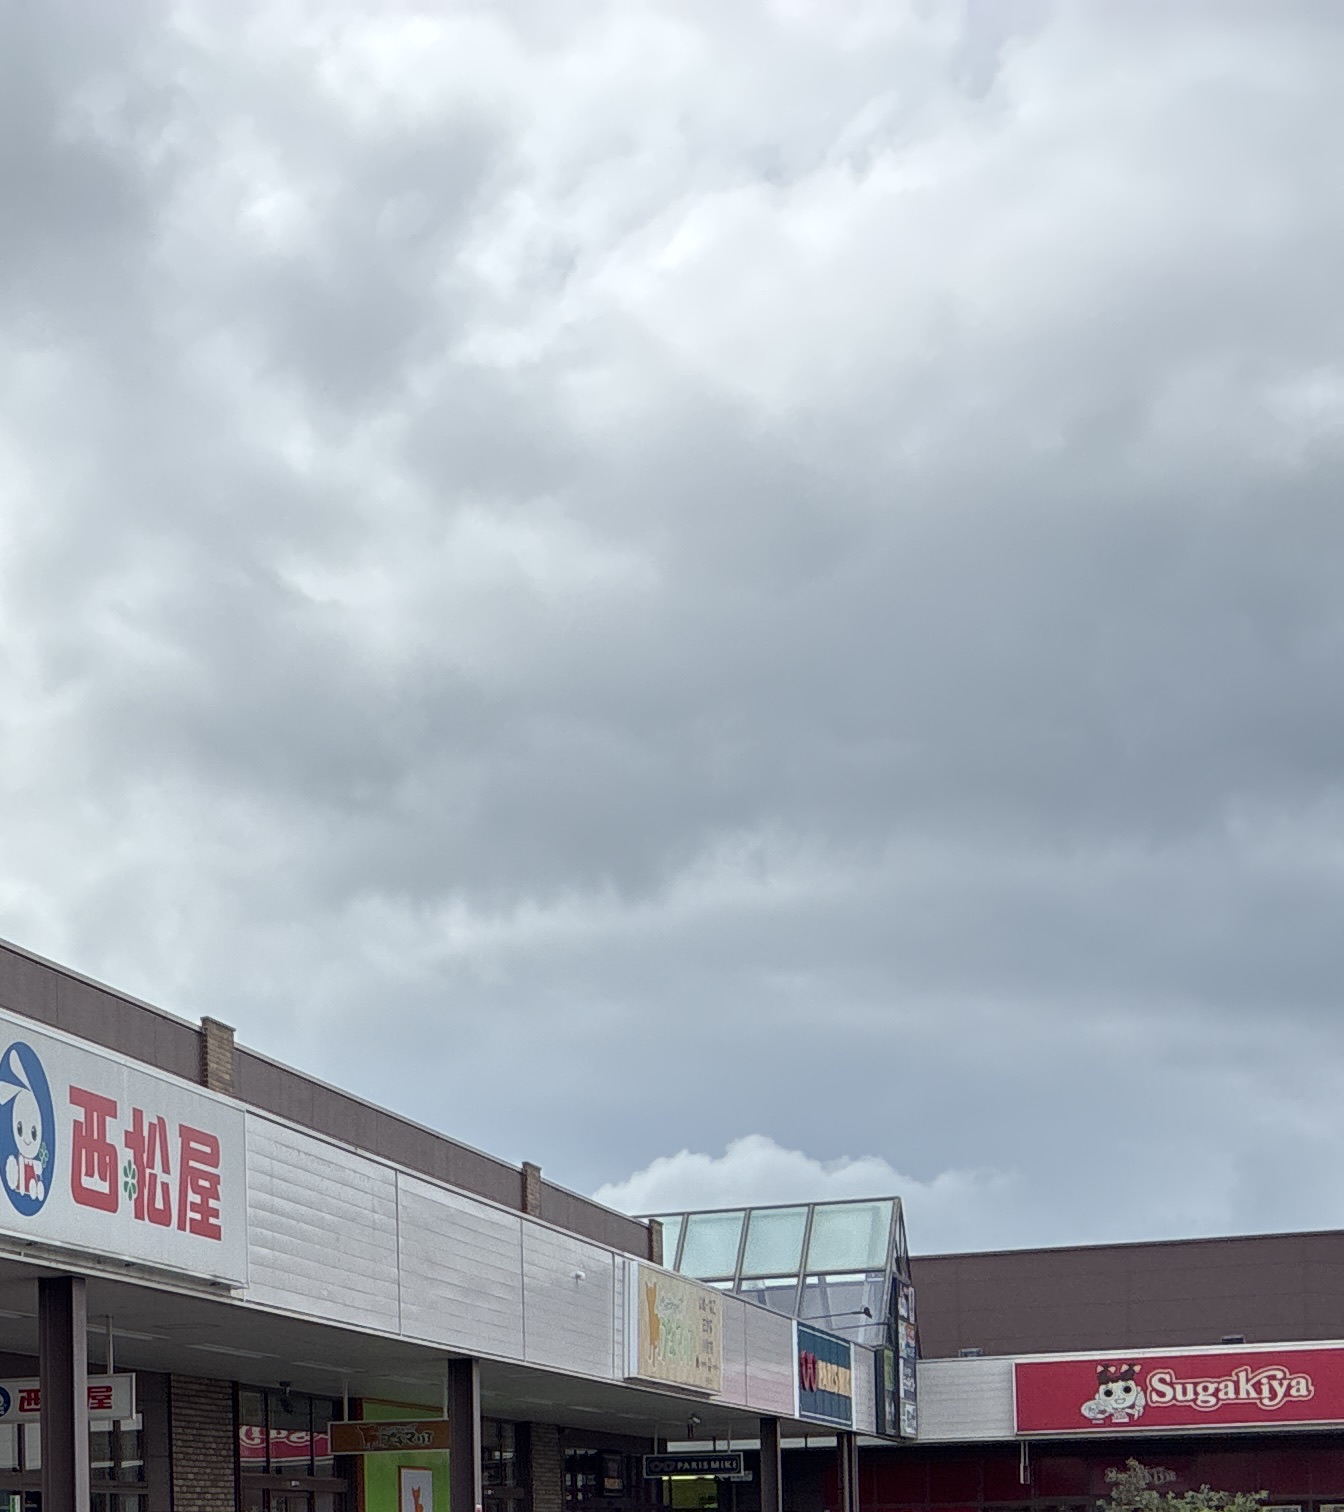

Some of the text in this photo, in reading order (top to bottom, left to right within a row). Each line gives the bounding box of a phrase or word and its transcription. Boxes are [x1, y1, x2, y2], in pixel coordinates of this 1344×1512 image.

[69, 1085, 223, 1242] 西松屋
[18, 1385, 113, 1413] 西屋
[1150, 1368, 1310, 1408] Sugakiya
[676, 1460, 709, 1471] PARIS
